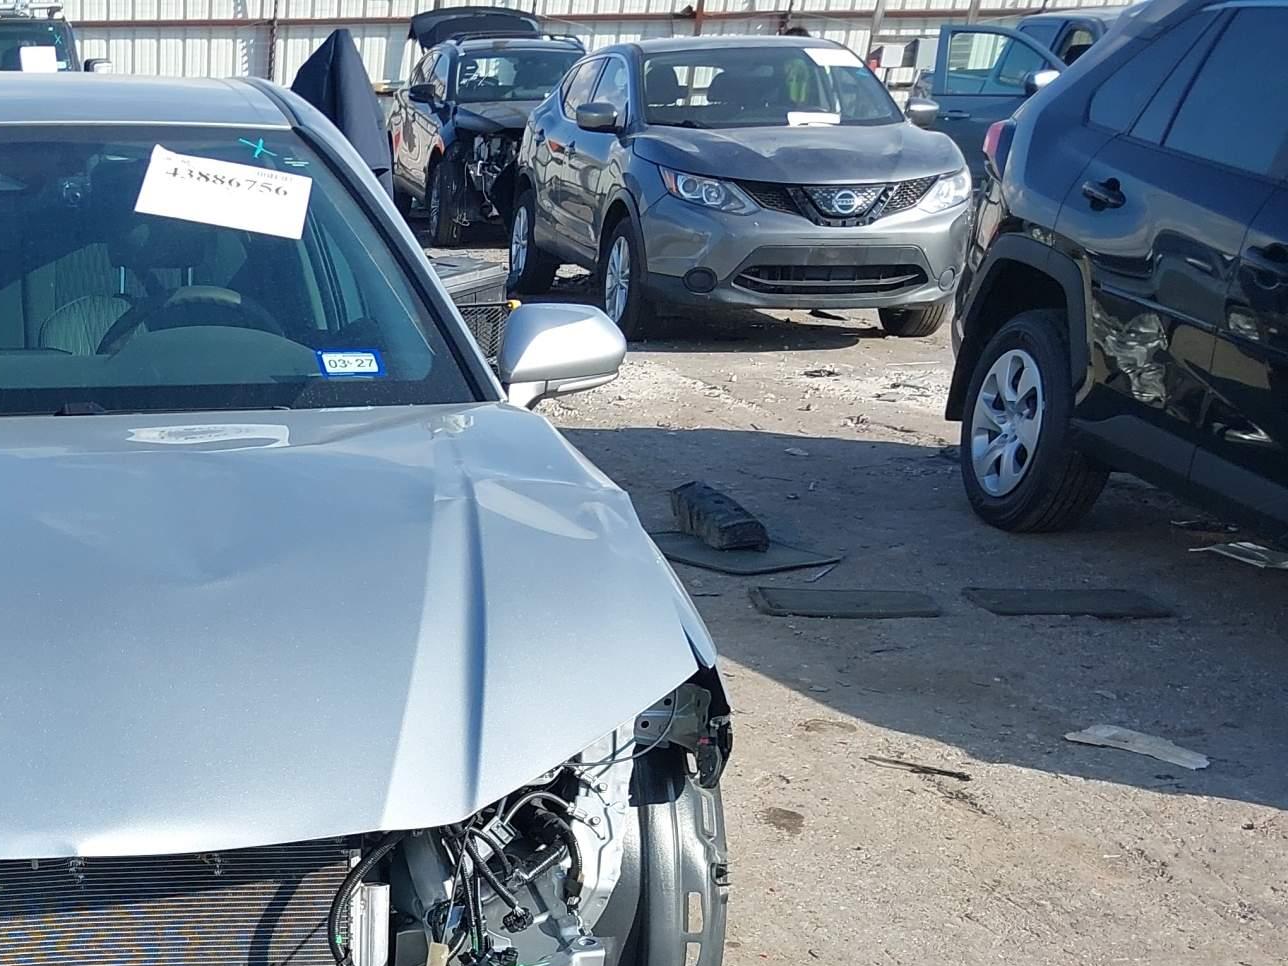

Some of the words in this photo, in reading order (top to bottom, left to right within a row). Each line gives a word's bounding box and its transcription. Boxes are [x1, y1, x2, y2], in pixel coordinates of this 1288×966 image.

[165, 167, 288, 196] 43886756
[328, 358, 348, 369] 03
[355, 358, 374, 368] 27
